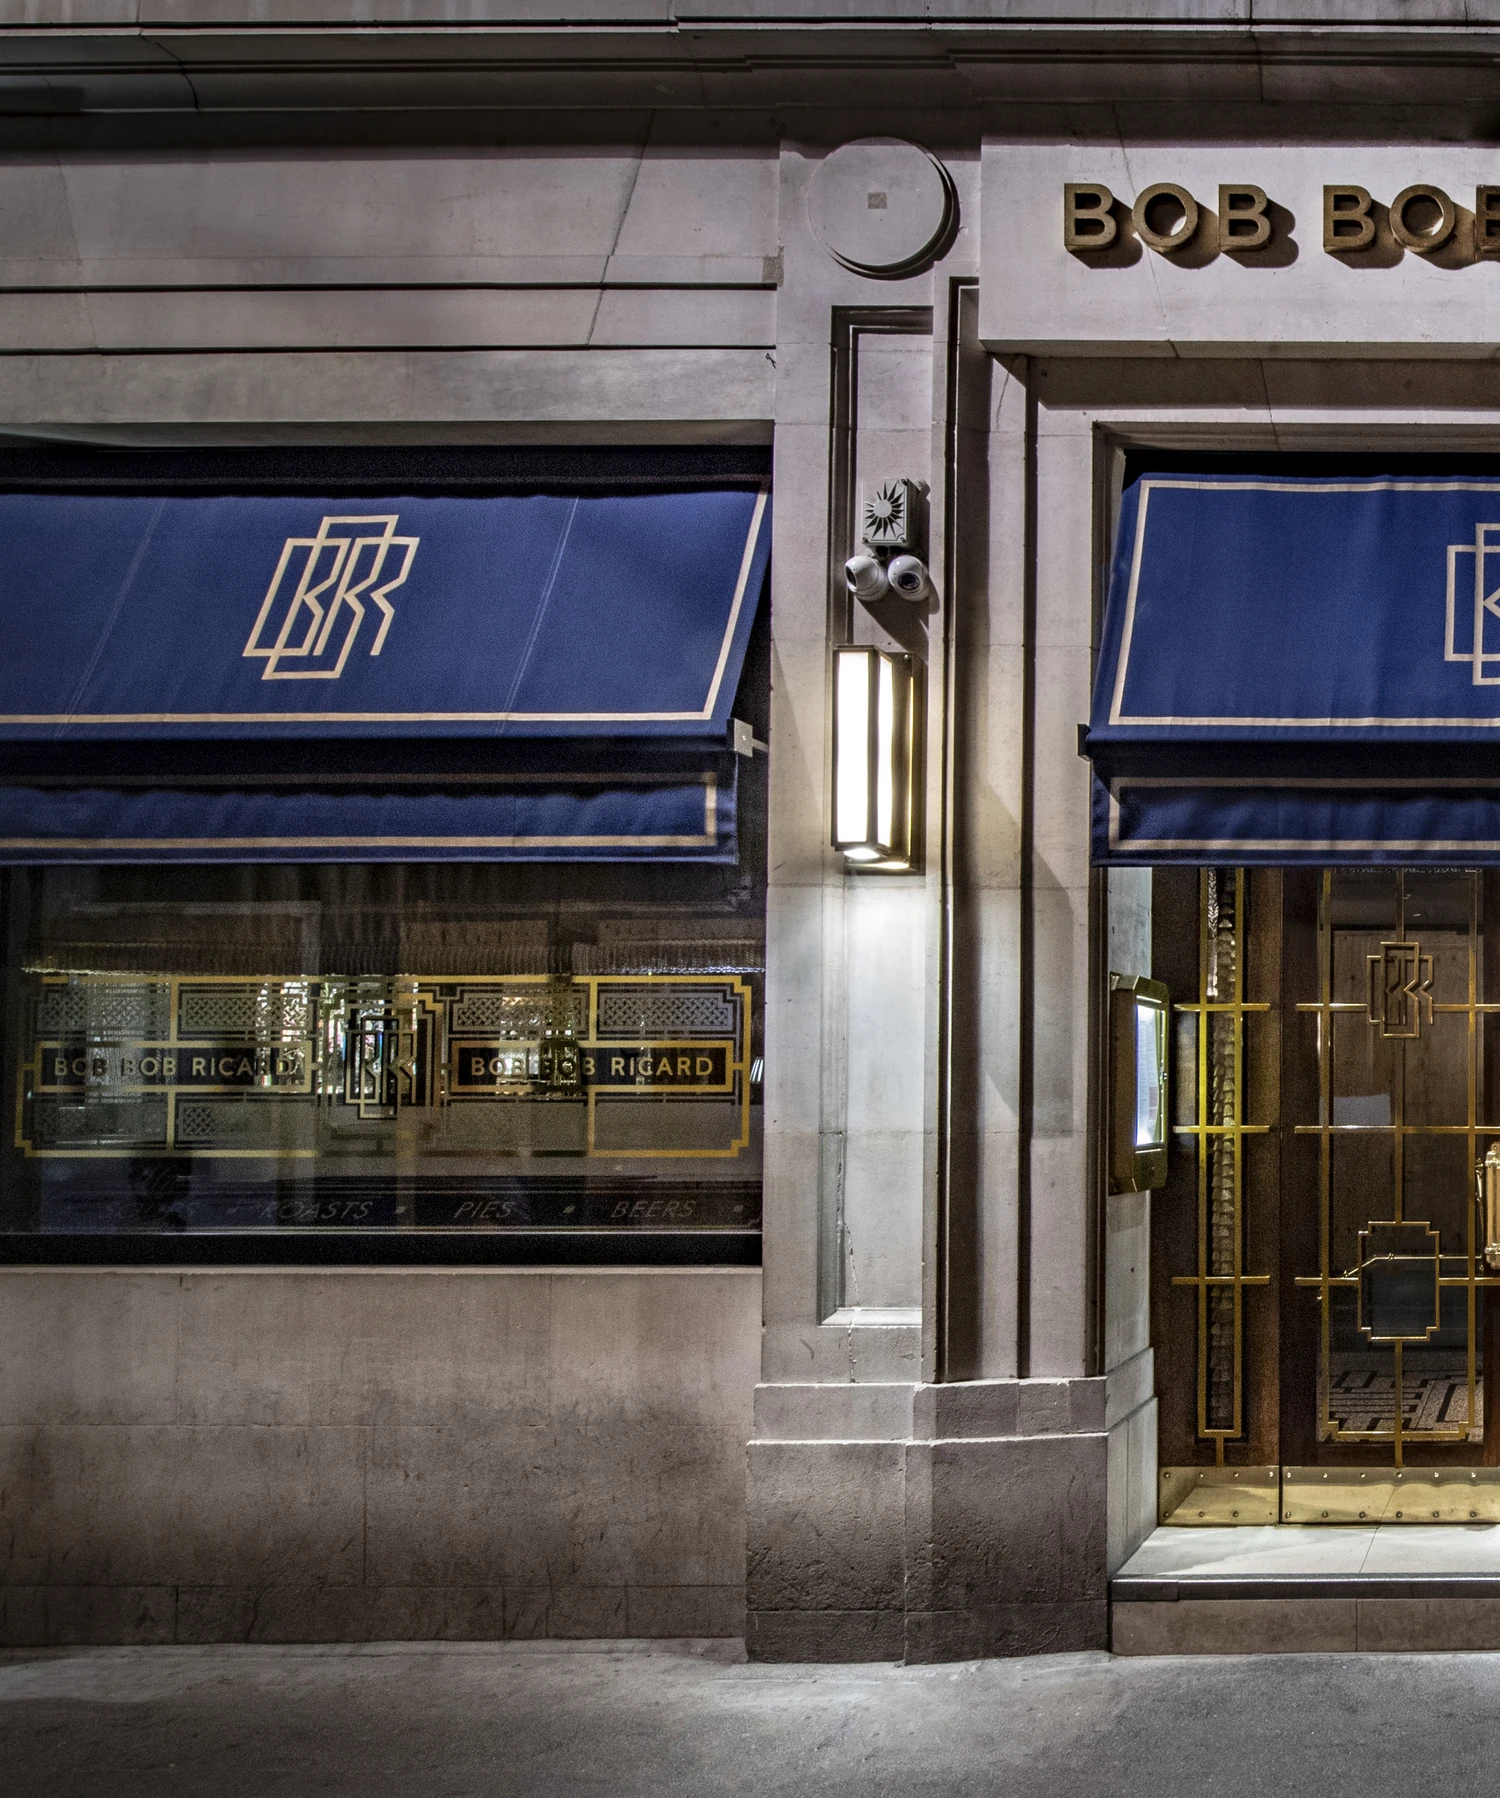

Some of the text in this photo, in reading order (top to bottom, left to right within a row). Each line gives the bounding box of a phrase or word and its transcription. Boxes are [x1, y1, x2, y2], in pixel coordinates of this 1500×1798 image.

[1064, 183, 1273, 250] BOB
[54, 1057, 292, 1077] BOB BOB RICARD
[471, 1056, 524, 1076] BOB
[610, 1056, 713, 1076] RICARD
[260, 1200, 374, 1219] ROASTS
[453, 1200, 517, 1219] PIES
[610, 1200, 698, 1219] BEERS
